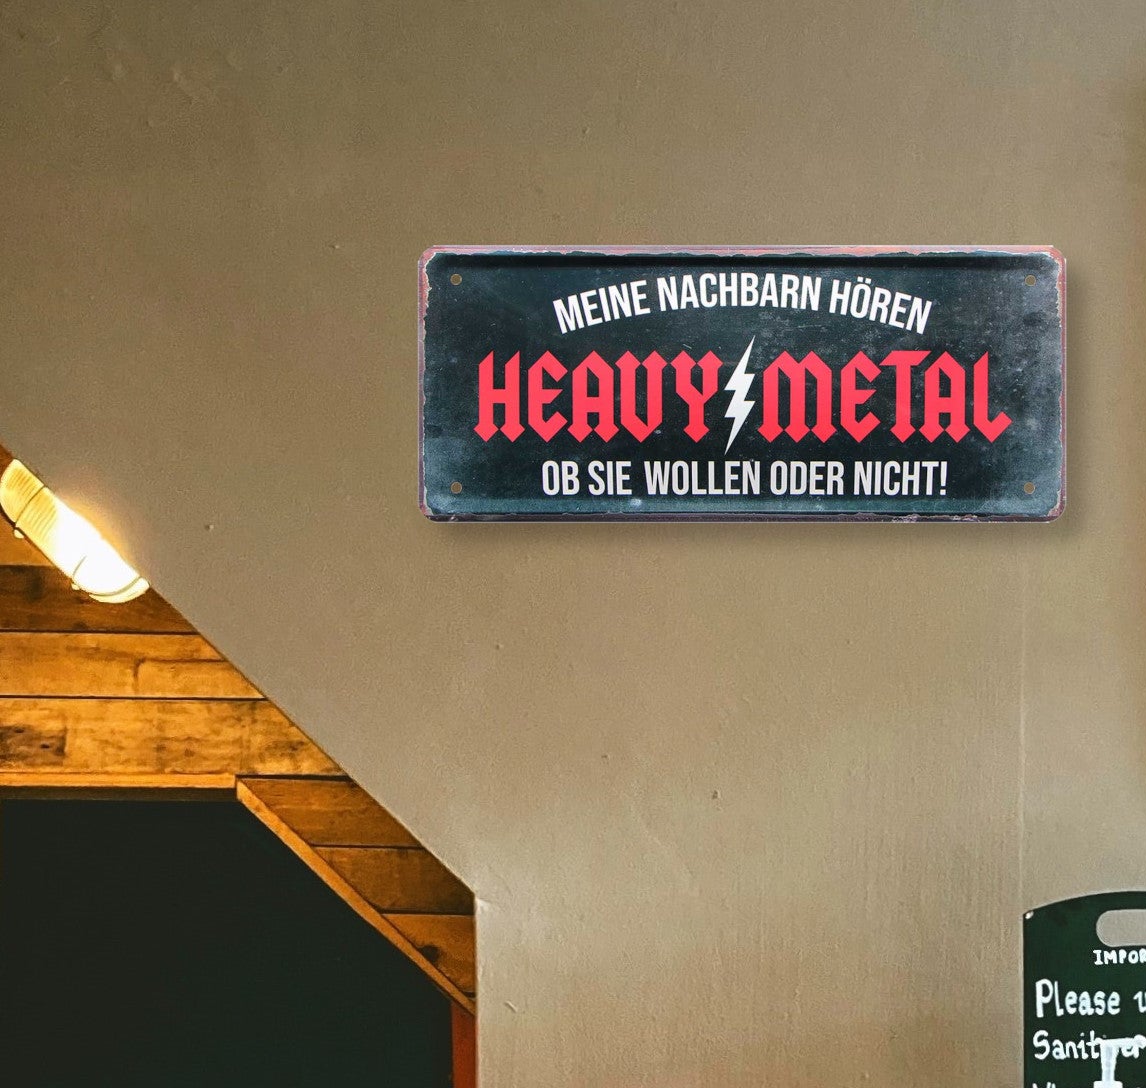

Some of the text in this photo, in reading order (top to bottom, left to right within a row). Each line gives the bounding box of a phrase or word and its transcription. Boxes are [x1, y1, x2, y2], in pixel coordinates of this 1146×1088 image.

[553, 272, 933, 334] MEINE NACHBARN HÖREN
[473, 350, 1013, 443] HEAVY METAL
[542, 460, 948, 496] OB SIE WOLLEN ODER NICHT!
[1035, 978, 1121, 1018] Please
